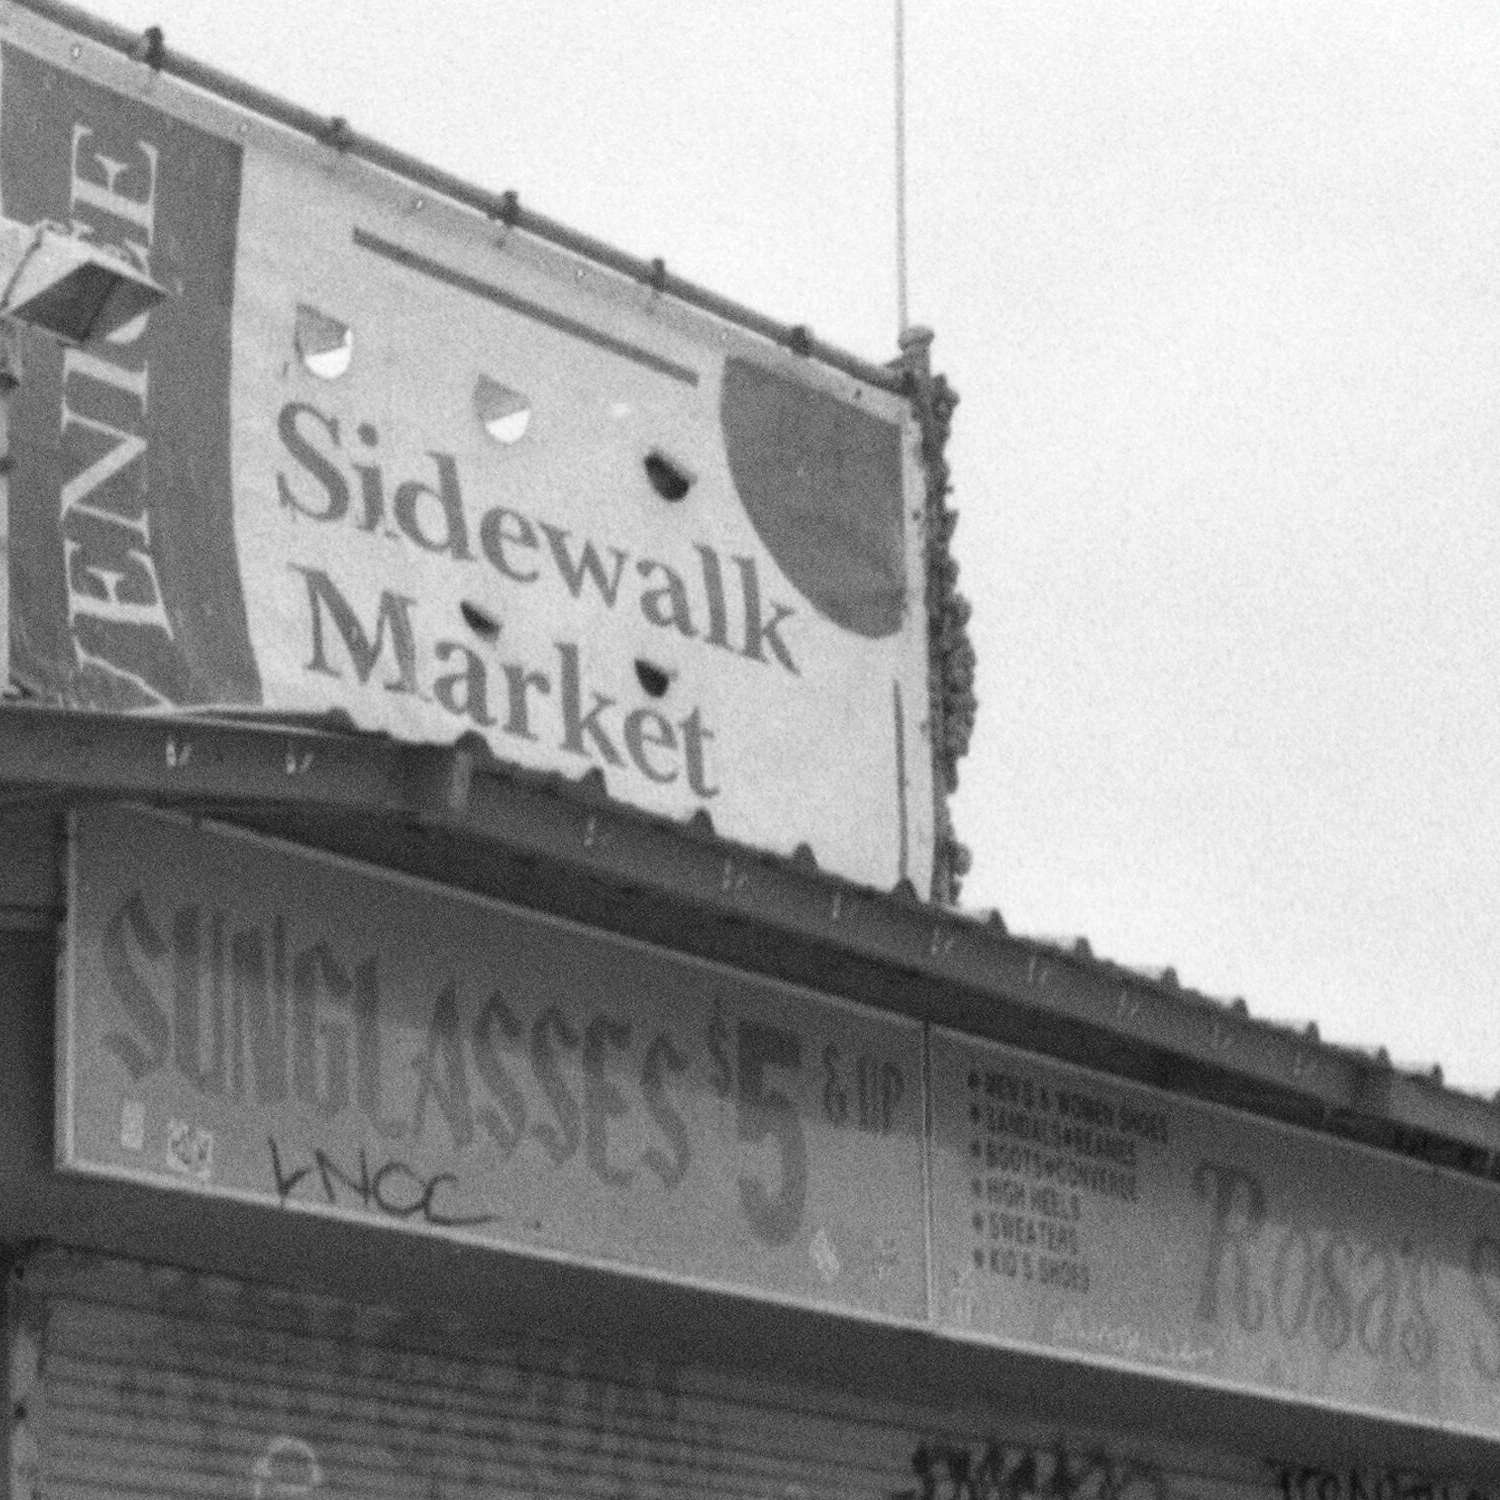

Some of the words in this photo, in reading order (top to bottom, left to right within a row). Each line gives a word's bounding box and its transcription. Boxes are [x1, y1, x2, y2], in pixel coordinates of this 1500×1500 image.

[275, 401, 802, 678] Sidewalk
[287, 562, 721, 797] Market
[101, 890, 689, 1191] SUNGLASSES
[857, 1055, 902, 1136] UP
[988, 1211, 1079, 1256] SWEATERS
